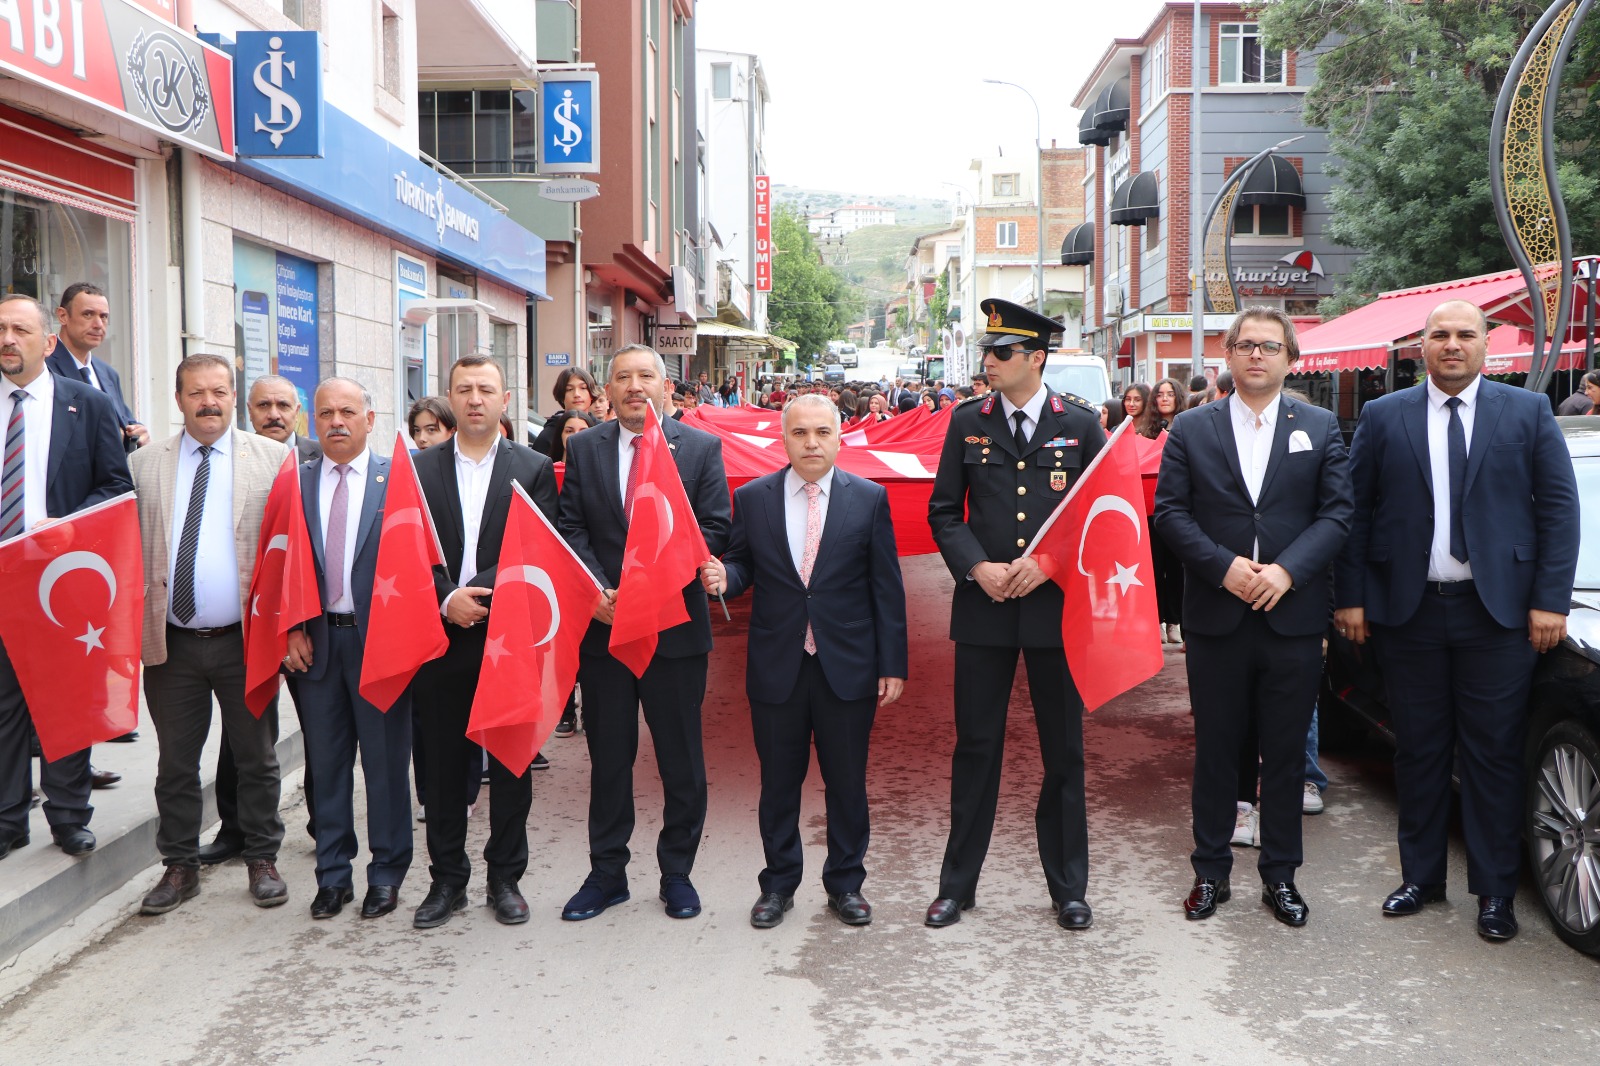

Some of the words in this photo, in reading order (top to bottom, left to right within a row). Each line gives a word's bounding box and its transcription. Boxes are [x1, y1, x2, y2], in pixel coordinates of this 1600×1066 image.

[545, 185, 591, 195] Bankamatik
[393, 170, 436, 220] TÜRKİYE
[445, 202, 479, 242] BANKASI
[756, 179, 768, 227] OTEL
[399, 263, 424, 285] Bankamatik
[756, 238, 769, 287] ÜMİT
[278, 297, 298, 321] İmece
[297, 305, 314, 326] Kart,
[1152, 317, 1194, 328] MEYDA
[659, 334, 693, 351] SAATÇİ
